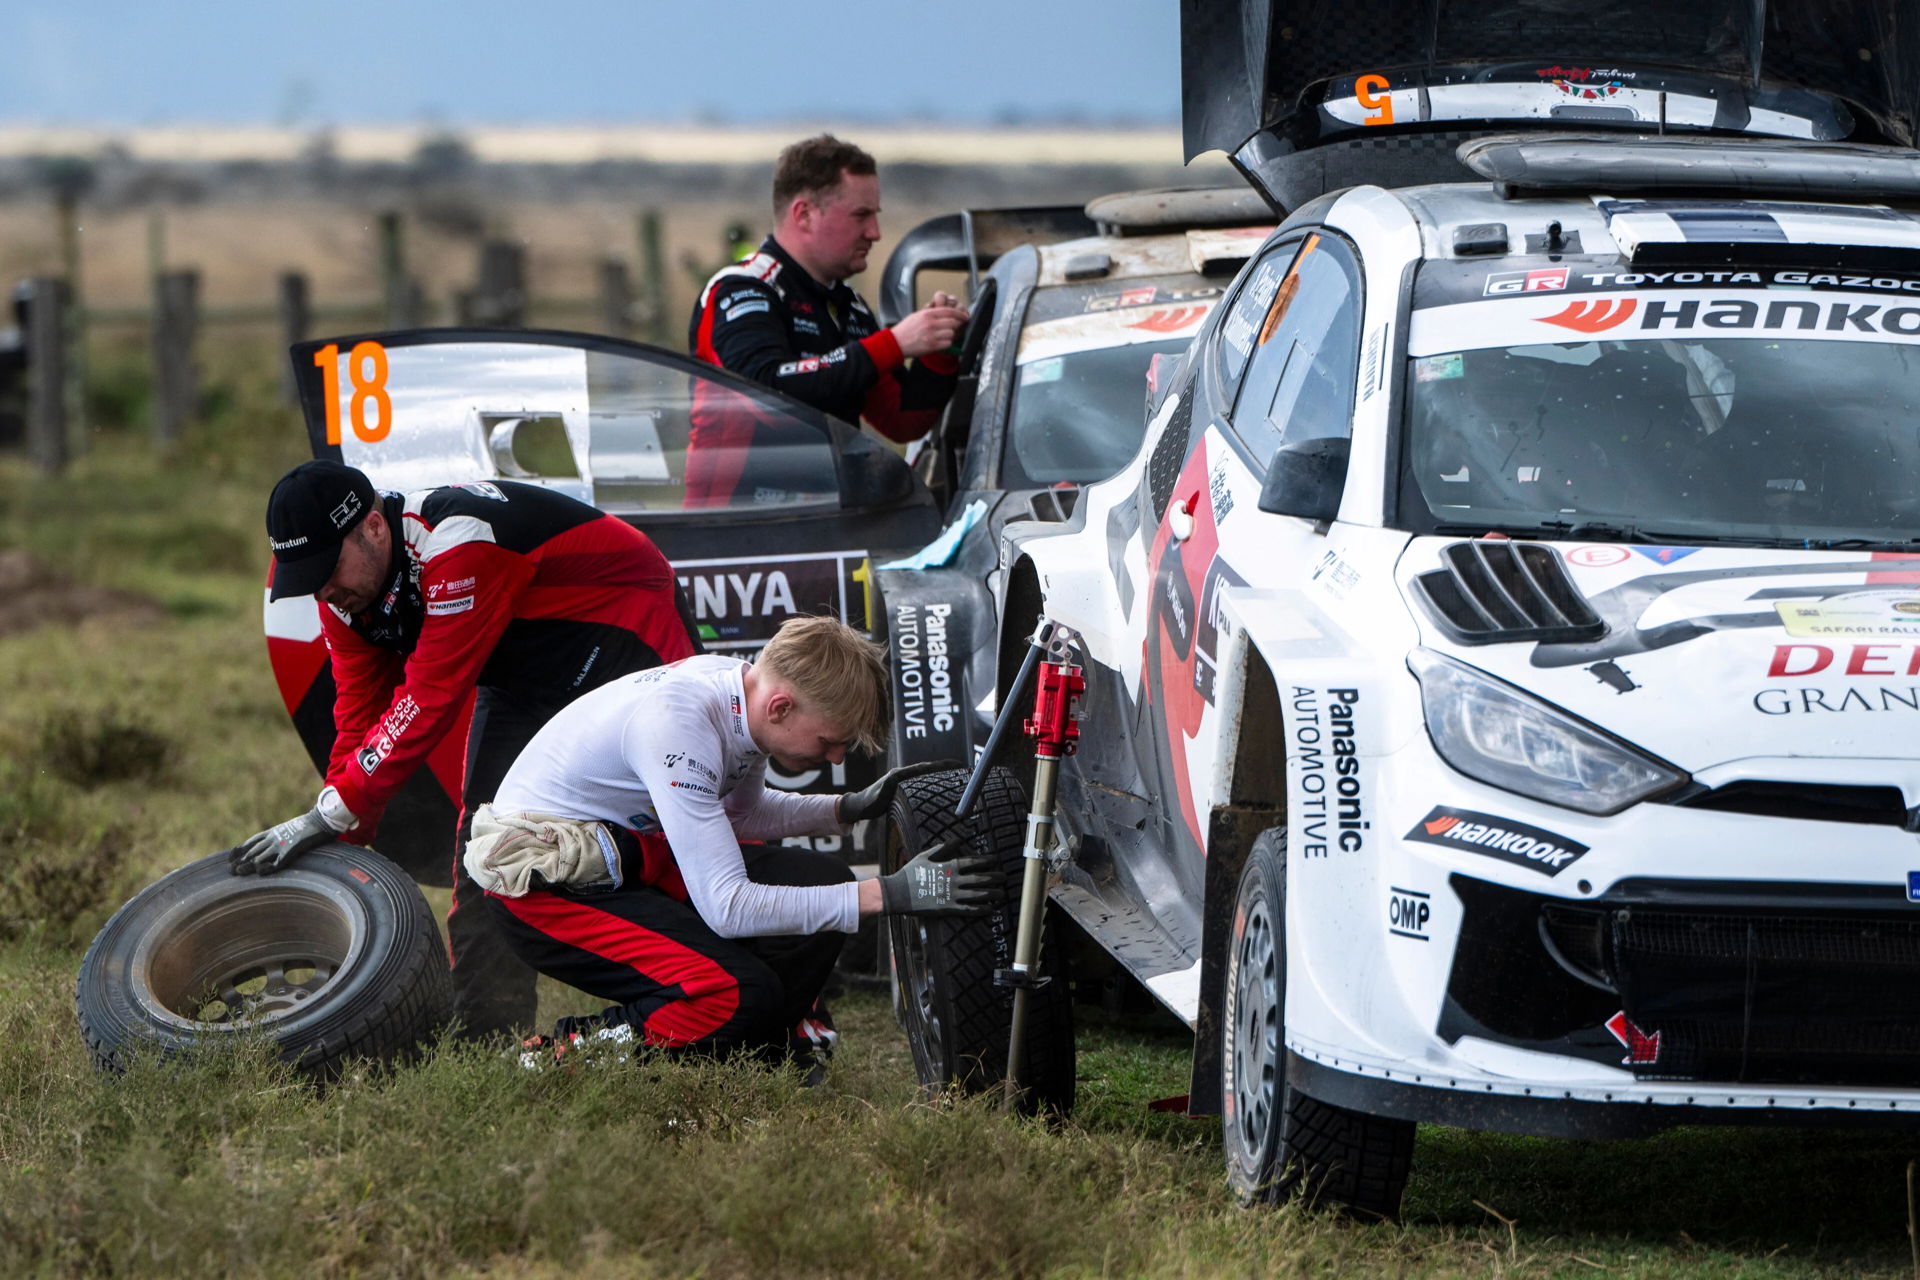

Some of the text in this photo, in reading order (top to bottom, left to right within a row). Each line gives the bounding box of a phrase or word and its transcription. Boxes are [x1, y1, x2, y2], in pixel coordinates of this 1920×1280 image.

[1354, 73, 1395, 126] 5
[1488, 275, 1565, 294] GR
[1582, 271, 1761, 286] TOYOTA
[313, 341, 392, 446] 18
[1810, 626, 1874, 634] SAFARI
[572, 646, 601, 689] SALMINEN
[897, 605, 927, 740] AUTOMOTIVE
[925, 603, 960, 733] Panasonic
[362, 736, 392, 773] GR
[1291, 685, 1328, 860] AUTOMOTIVE
[1328, 687, 1370, 854] Panasonic
[1389, 896, 1430, 934] OMP
